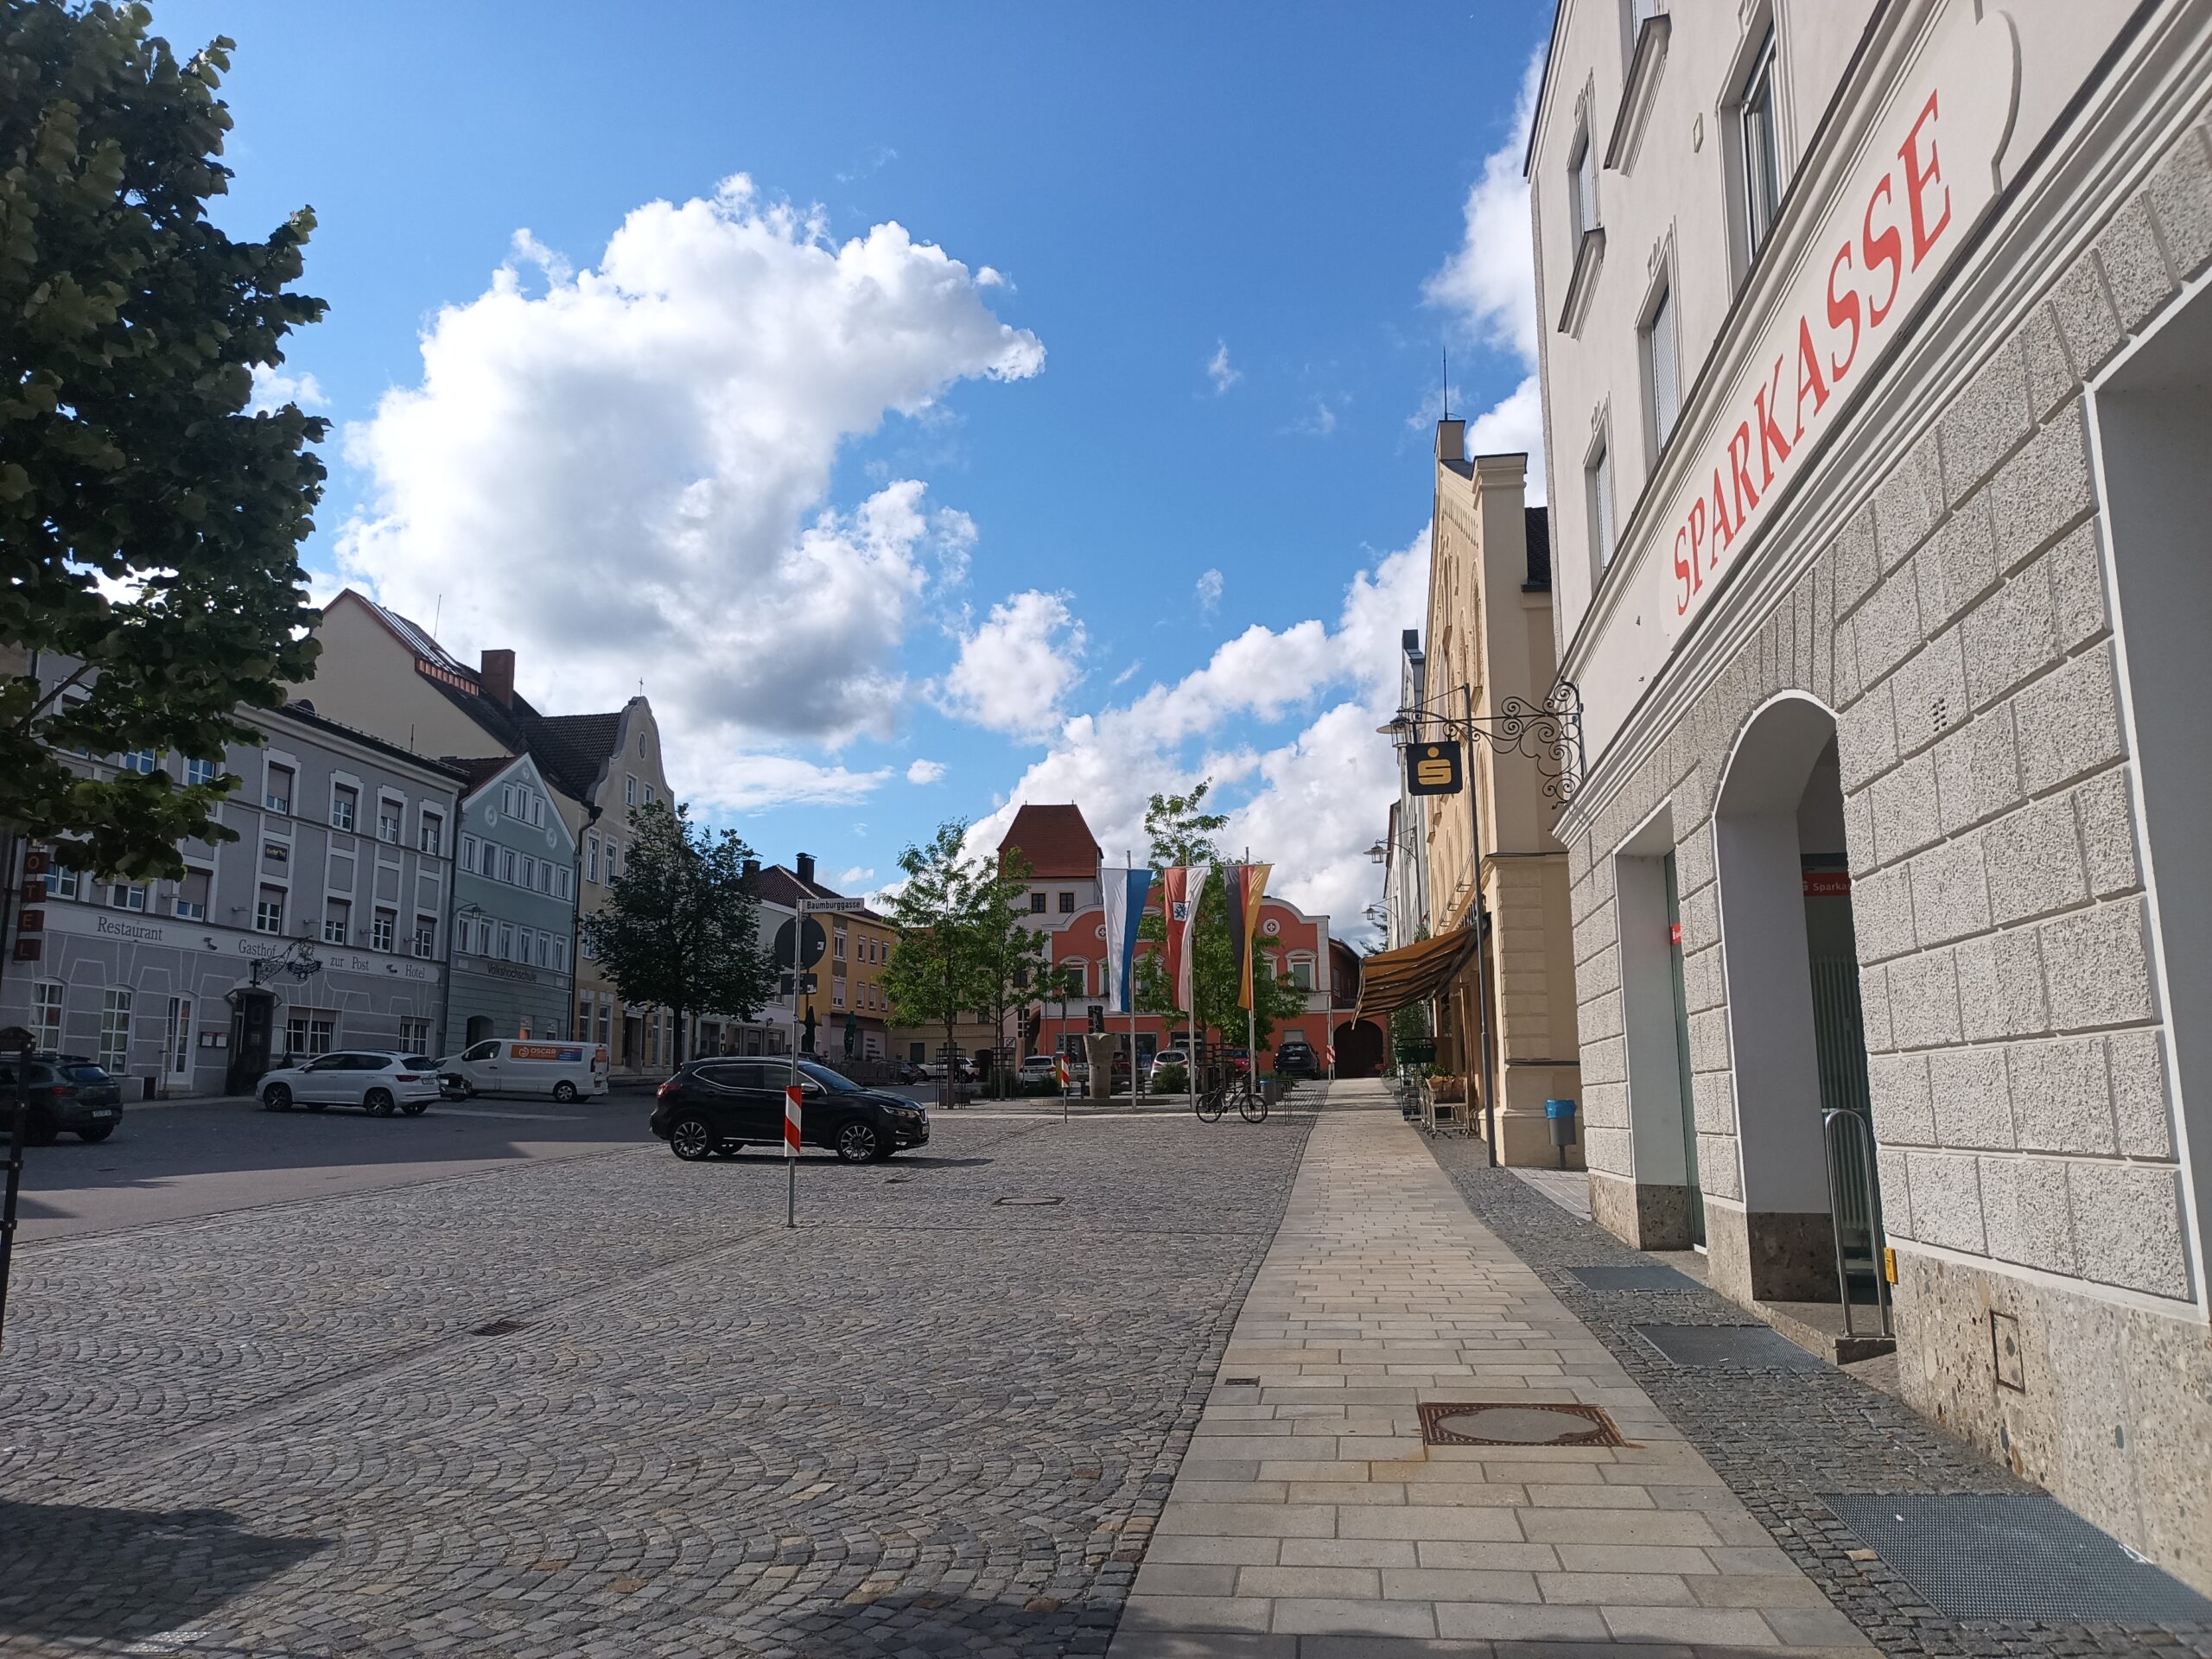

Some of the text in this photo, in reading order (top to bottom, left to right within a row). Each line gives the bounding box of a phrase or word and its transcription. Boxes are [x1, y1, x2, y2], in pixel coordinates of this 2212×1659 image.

[1675, 88, 1952, 616] SPARKASSE
[806, 900, 861, 910] Baumburggasse
[97, 916, 425, 979] Restaurant Gasthof zur Post Hotel
[486, 962, 538, 982] Volkshochschule
